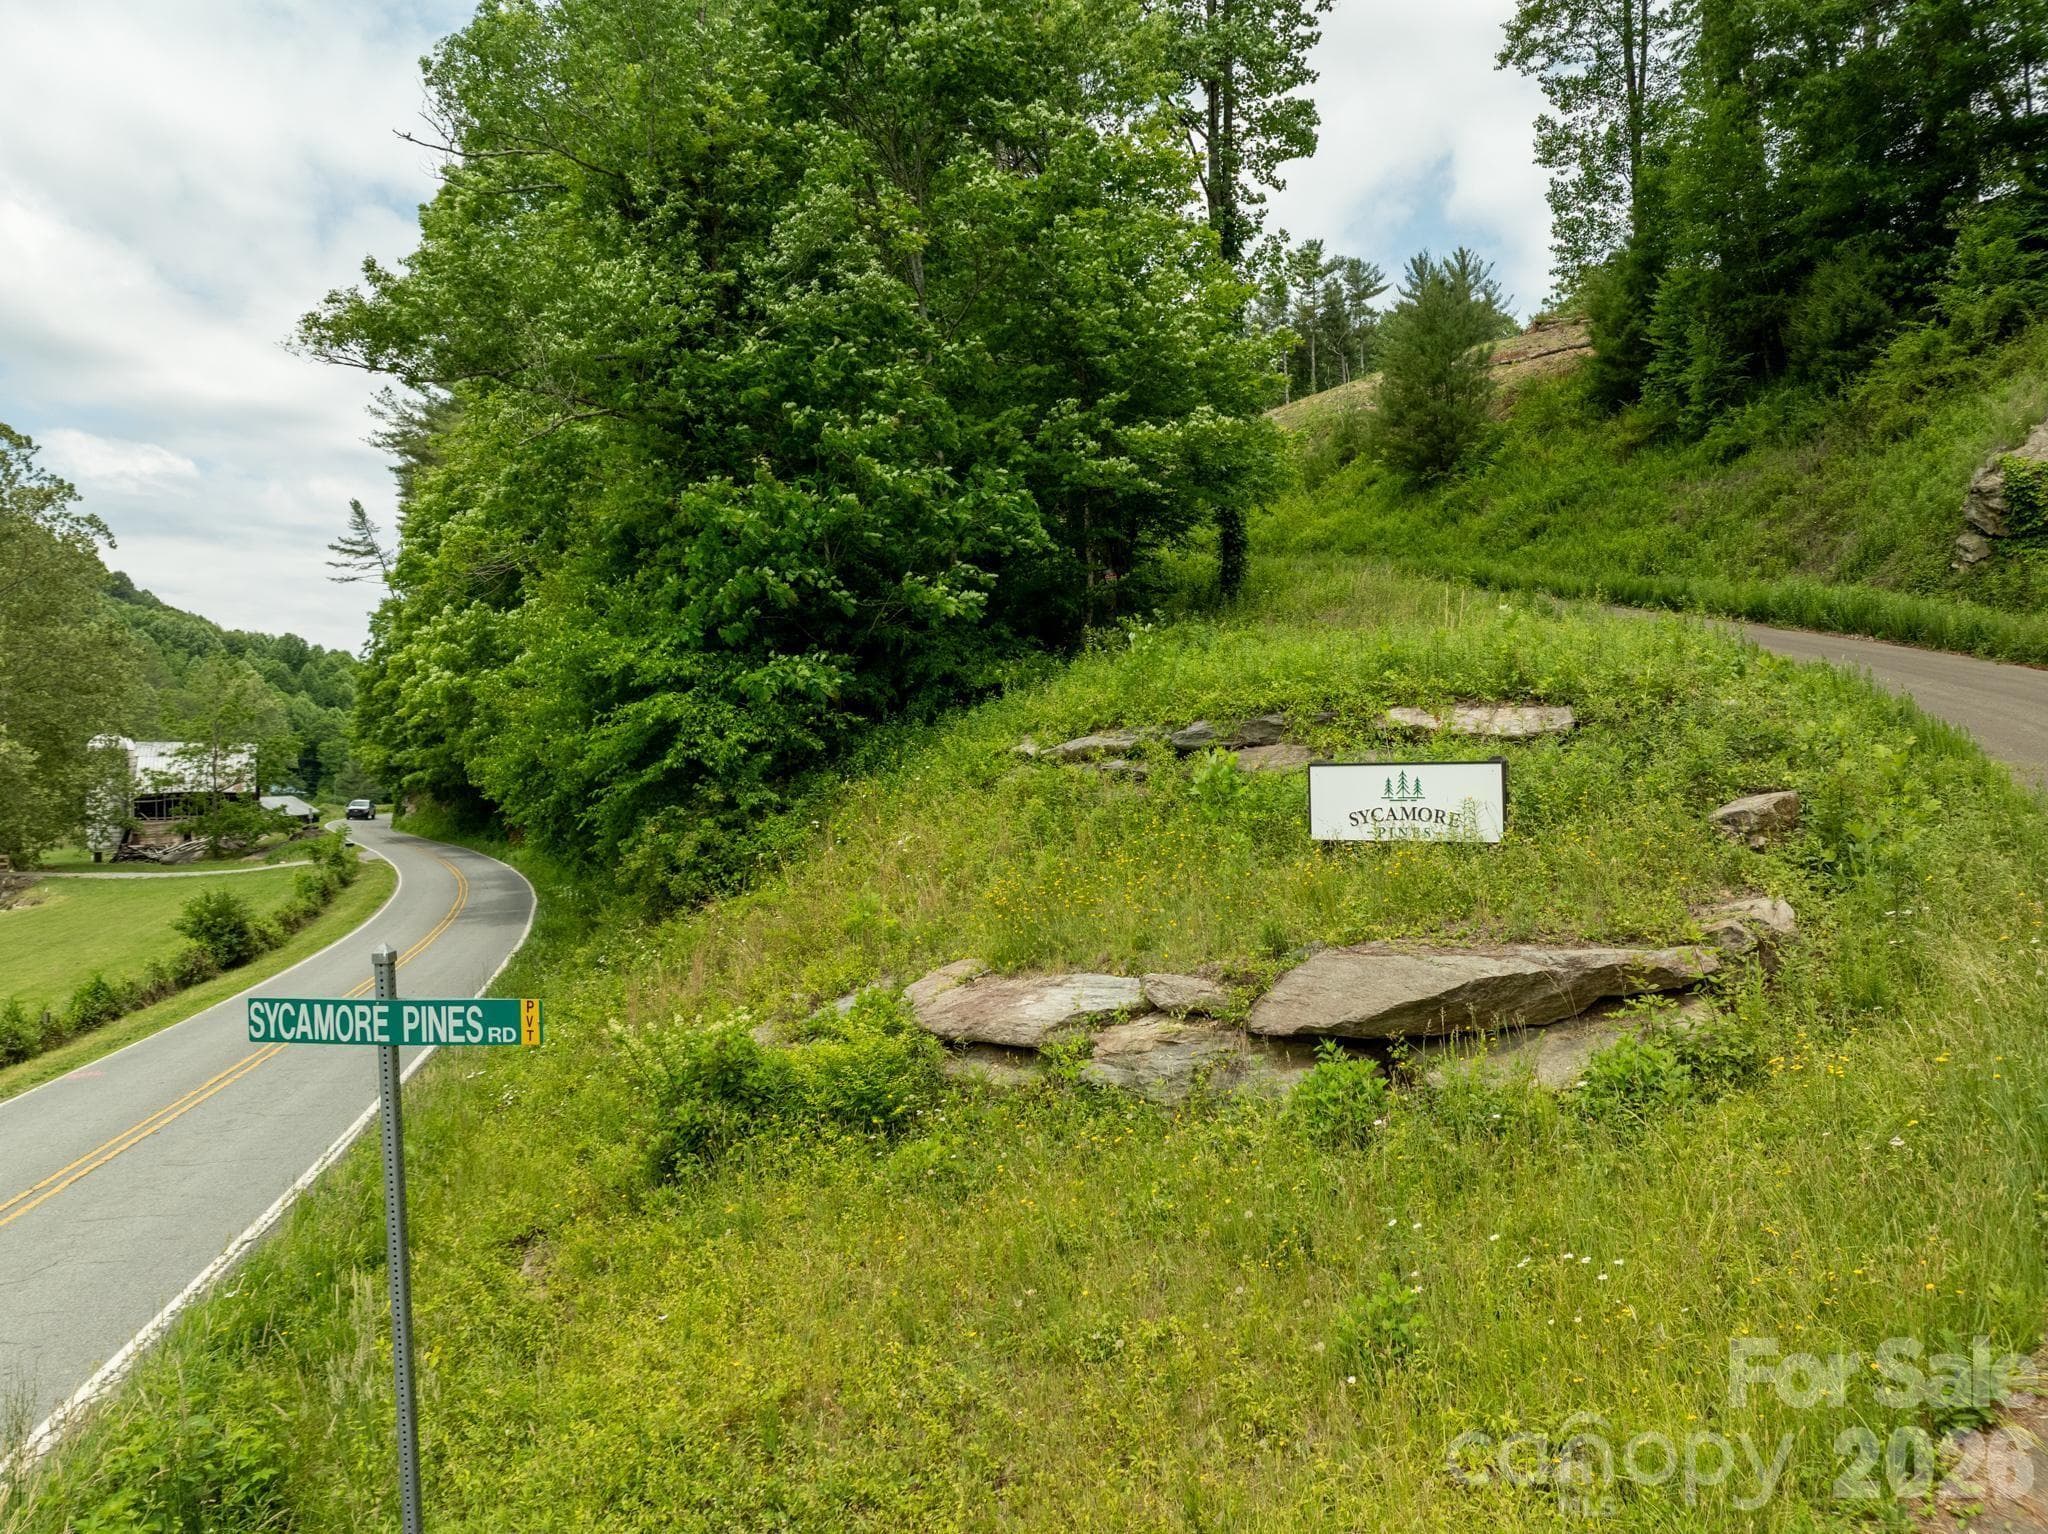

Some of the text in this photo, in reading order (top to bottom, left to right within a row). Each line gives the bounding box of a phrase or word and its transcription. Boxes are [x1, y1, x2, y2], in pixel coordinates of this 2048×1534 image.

[1349, 807, 1462, 828] SYCAMORE
[1377, 826, 1431, 838] PINES
[249, 1001, 517, 1043] SYCAMORE PINES RD
[526, 1000, 535, 1042] PVT
